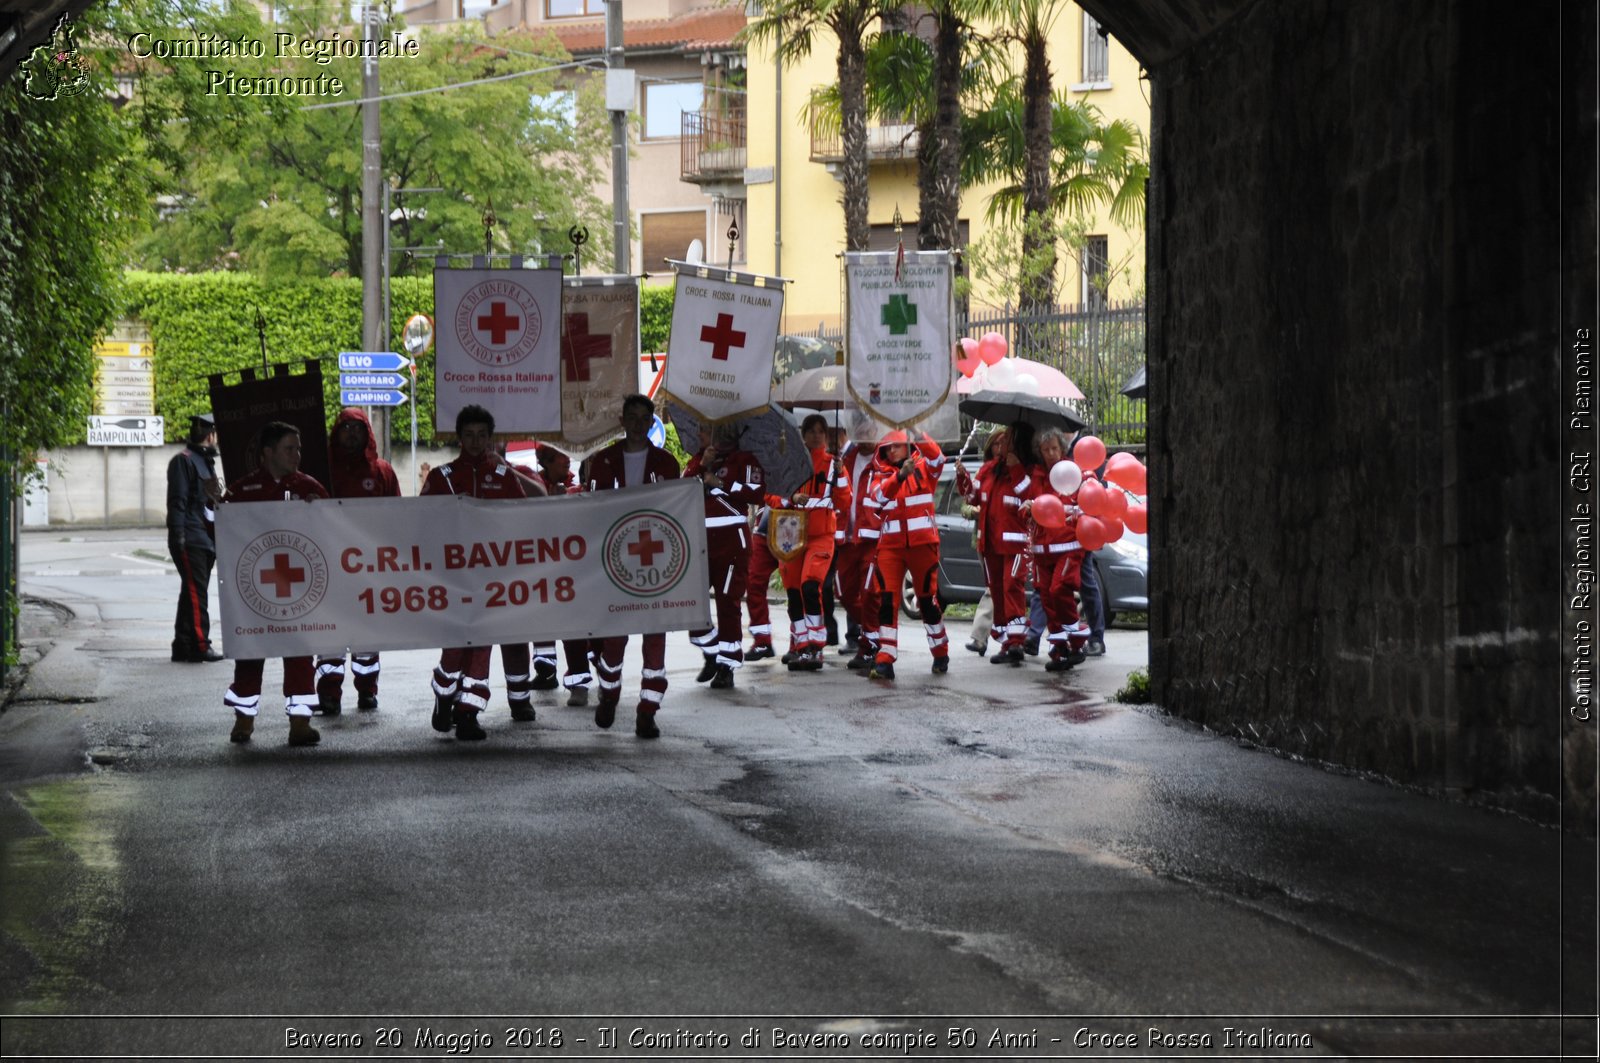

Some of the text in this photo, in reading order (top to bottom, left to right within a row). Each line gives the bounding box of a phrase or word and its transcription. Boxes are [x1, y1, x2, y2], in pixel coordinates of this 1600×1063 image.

[904, 268, 944, 277] VOLONTARI
[479, 283, 520, 298] GINEVRA
[861, 280, 893, 289] PUBBLICA
[467, 291, 480, 303] DI
[564, 294, 633, 304] OSSA ITALIANA
[685, 286, 772, 308] CROCE ROSSA ITALIANA
[458, 304, 493, 362] CONVENZIONE
[524, 311, 539, 349] AGOSTO
[876, 340, 922, 348] CROCE VERDE
[342, 356, 372, 366] LEVO
[866, 353, 932, 362] GRAVELLONA TOCE
[345, 376, 395, 384] SOMERARO
[444, 371, 554, 382] Croce Rossa Italiana
[700, 371, 736, 384] COMITATO
[460, 385, 538, 394] Comitato di Baveno
[564, 390, 612, 399] EGAZIONE
[690, 386, 740, 400] DOMODOSSOLA
[882, 388, 930, 397] PROVINCIA
[348, 393, 391, 402] CAMPINO
[90, 432, 146, 442] RAMPOLINA
[262, 534, 308, 552] GINEVRA
[253, 544, 264, 557] DI
[306, 549, 319, 562] 22
[340, 534, 587, 574] C.R.I. BAVENO
[308, 562, 326, 606] AGOSTO
[635, 567, 660, 588] 50
[240, 556, 278, 617] CONVENZIONE
[358, 584, 449, 614] 1968
[484, 576, 576, 608] 2018
[608, 599, 697, 613] Comitato di Baveno
[235, 622, 336, 636] Croce Rossa Italiana
